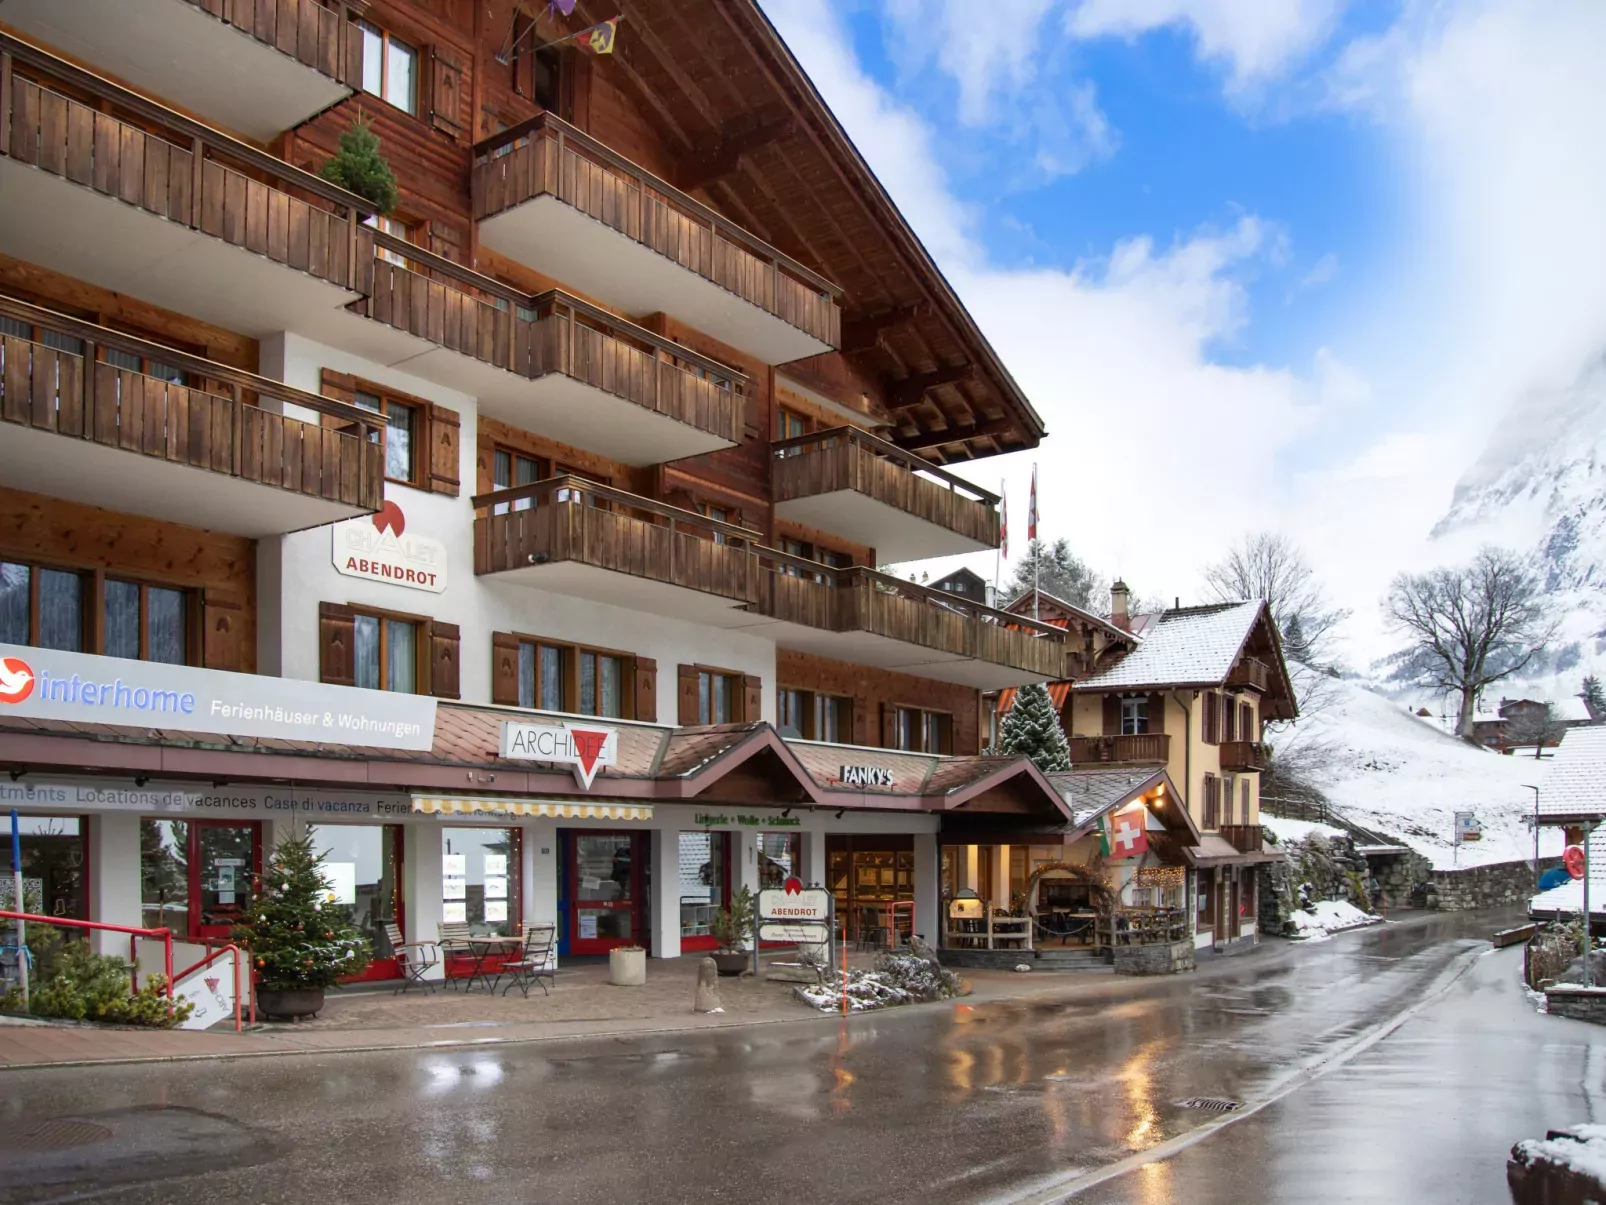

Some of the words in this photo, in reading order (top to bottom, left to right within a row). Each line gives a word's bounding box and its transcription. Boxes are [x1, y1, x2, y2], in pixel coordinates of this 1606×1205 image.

[346, 557, 437, 586] ABENDROT
[40, 669, 195, 715] interhome
[210, 700, 320, 725] Ferienhäuser
[322, 711, 334, 728] &
[338, 713, 420, 738] Wohnungen
[511, 729, 606, 760] ARCHIDEE
[841, 765, 894, 786] FANKY'S
[76, 785, 158, 805] Locations
[162, 792, 182, 806] de
[187, 795, 257, 809] vacances
[264, 796, 298, 810] Case
[302, 798, 314, 811] di
[317, 799, 370, 812] vacanza
[771, 908, 817, 916] ABENDROT
